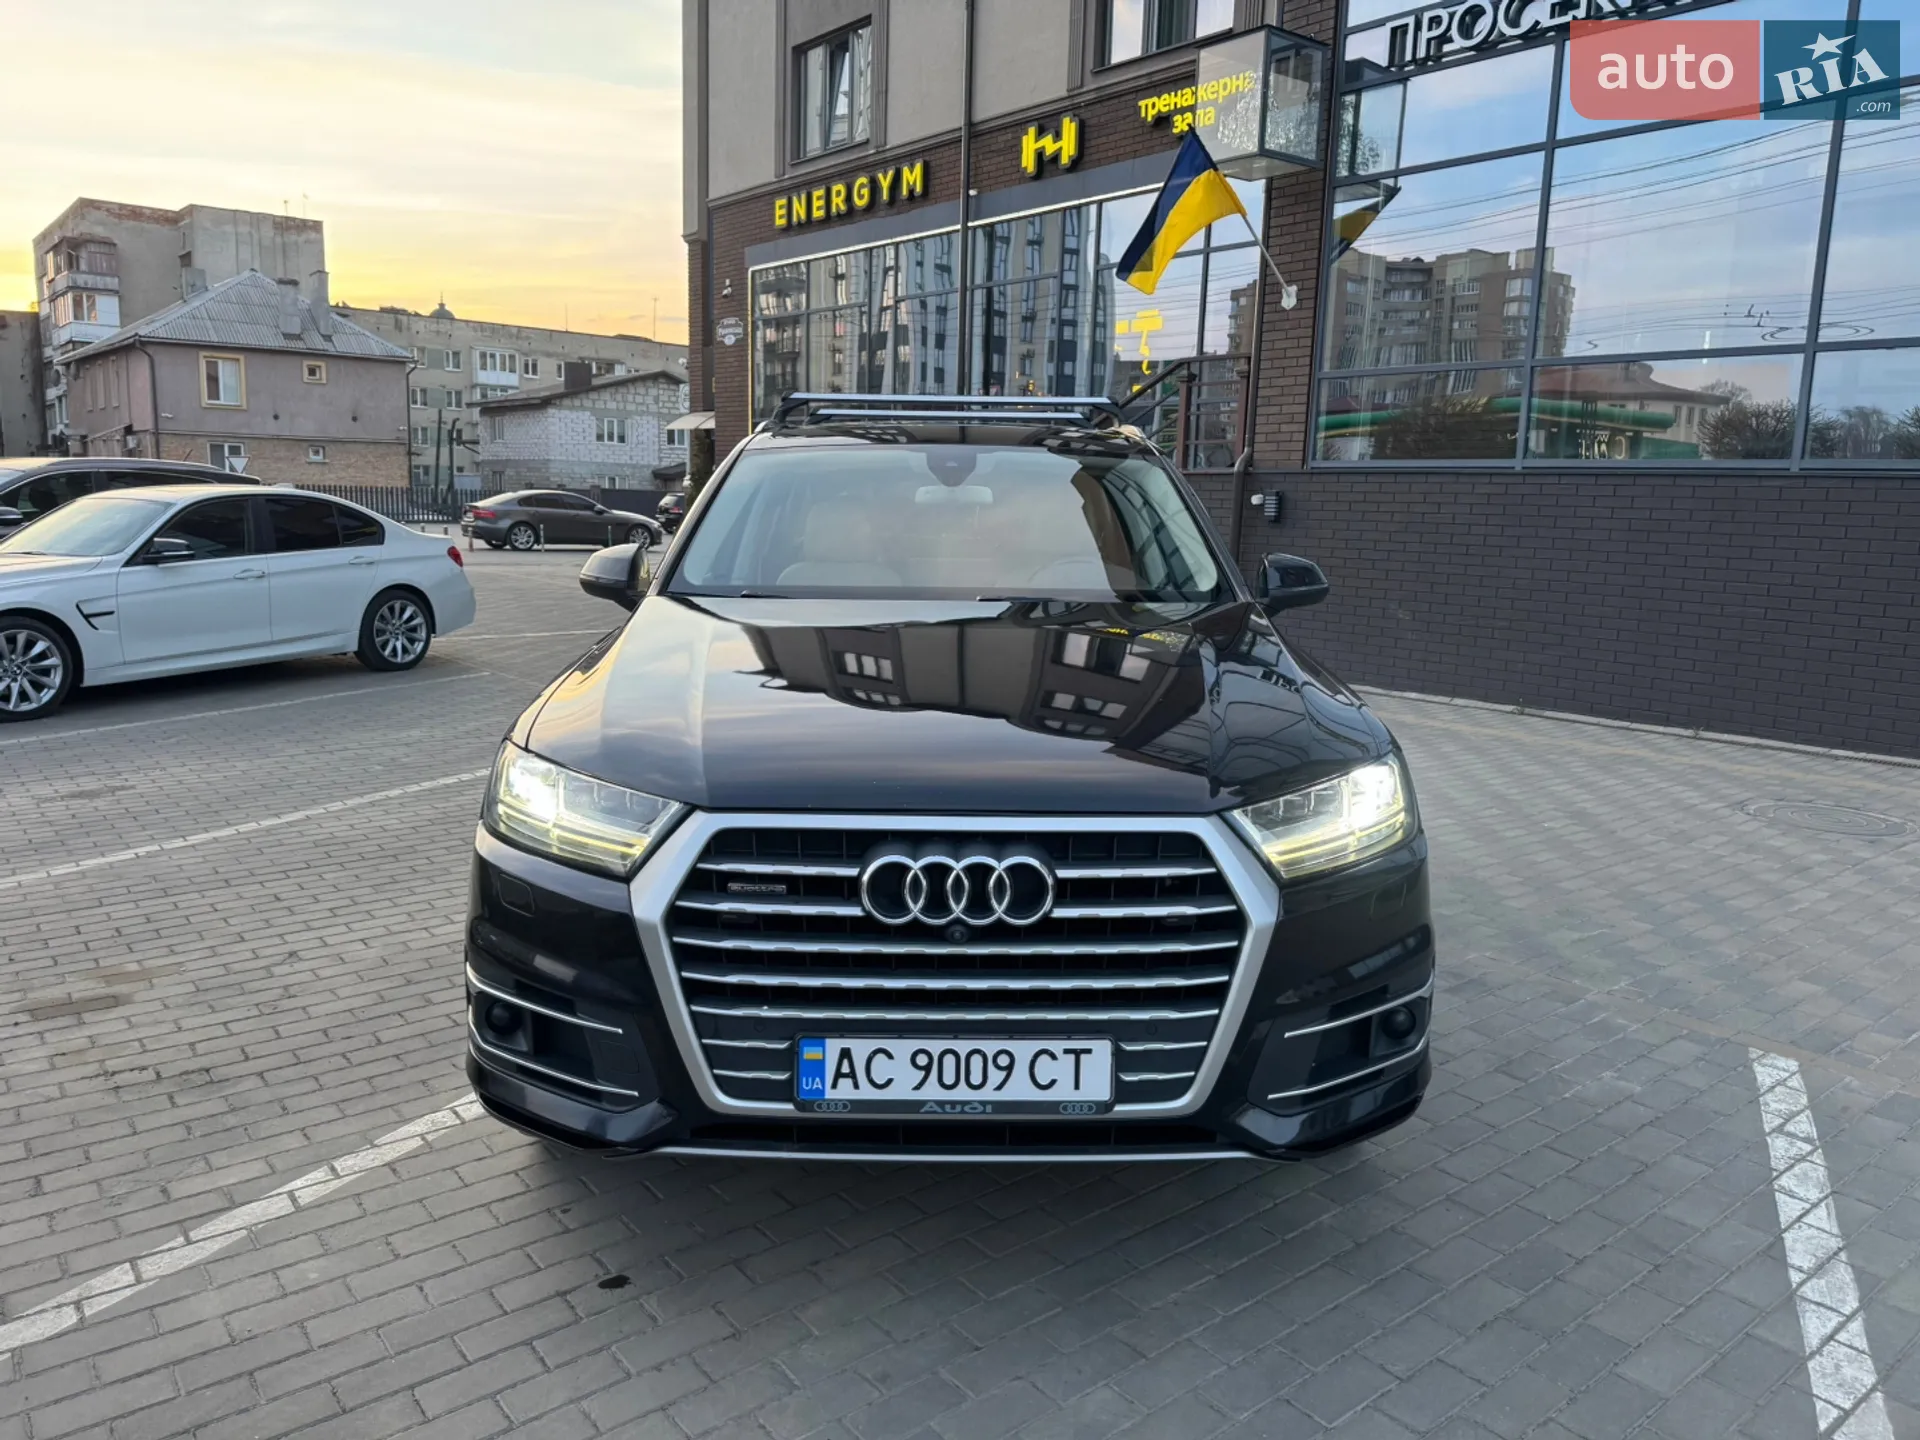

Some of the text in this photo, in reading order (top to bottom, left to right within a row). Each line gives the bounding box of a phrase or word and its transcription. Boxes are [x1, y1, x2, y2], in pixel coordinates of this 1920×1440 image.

[774, 161, 924, 229] ENERGYM
[802, 1076, 824, 1090] UA
[830, 1046, 1093, 1092] AC 9009 CT
[919, 1101, 993, 1114] Audi
